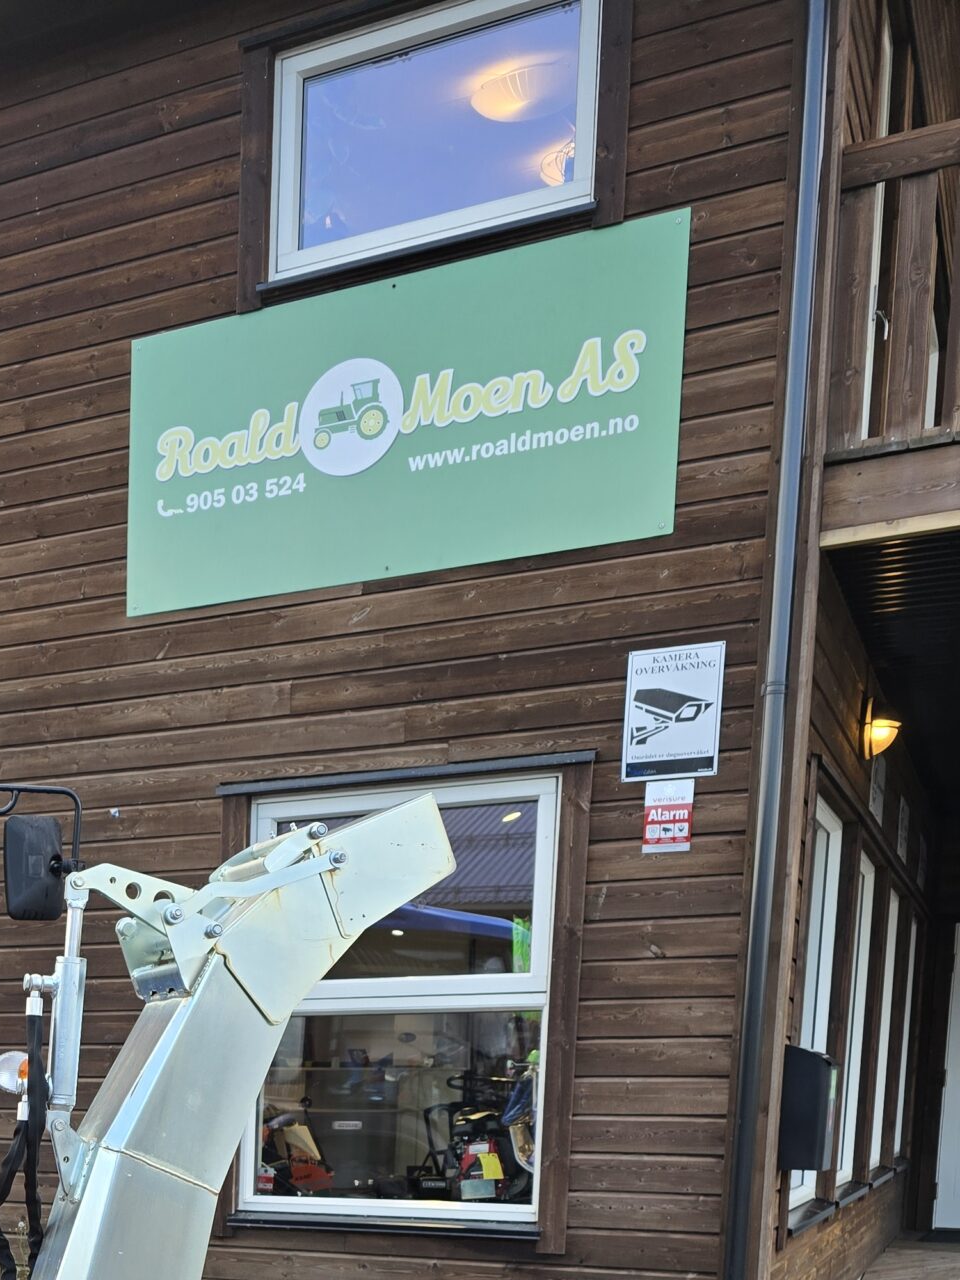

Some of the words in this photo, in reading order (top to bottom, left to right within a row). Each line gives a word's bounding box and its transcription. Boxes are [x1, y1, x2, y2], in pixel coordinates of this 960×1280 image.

[155, 401, 302, 482] Roald
[399, 368, 554, 434] Moen
[556, 329, 647, 403] AS
[408, 414, 640, 472] www.roaldmoen.no
[186, 488, 225, 513] 905
[231, 482, 258, 505] 03
[264, 472, 306, 499] 524
[635, 660, 716, 676] OVERVÅKNING
[652, 652, 700, 664] KAMERA
[648, 808, 689, 821] Alarm
